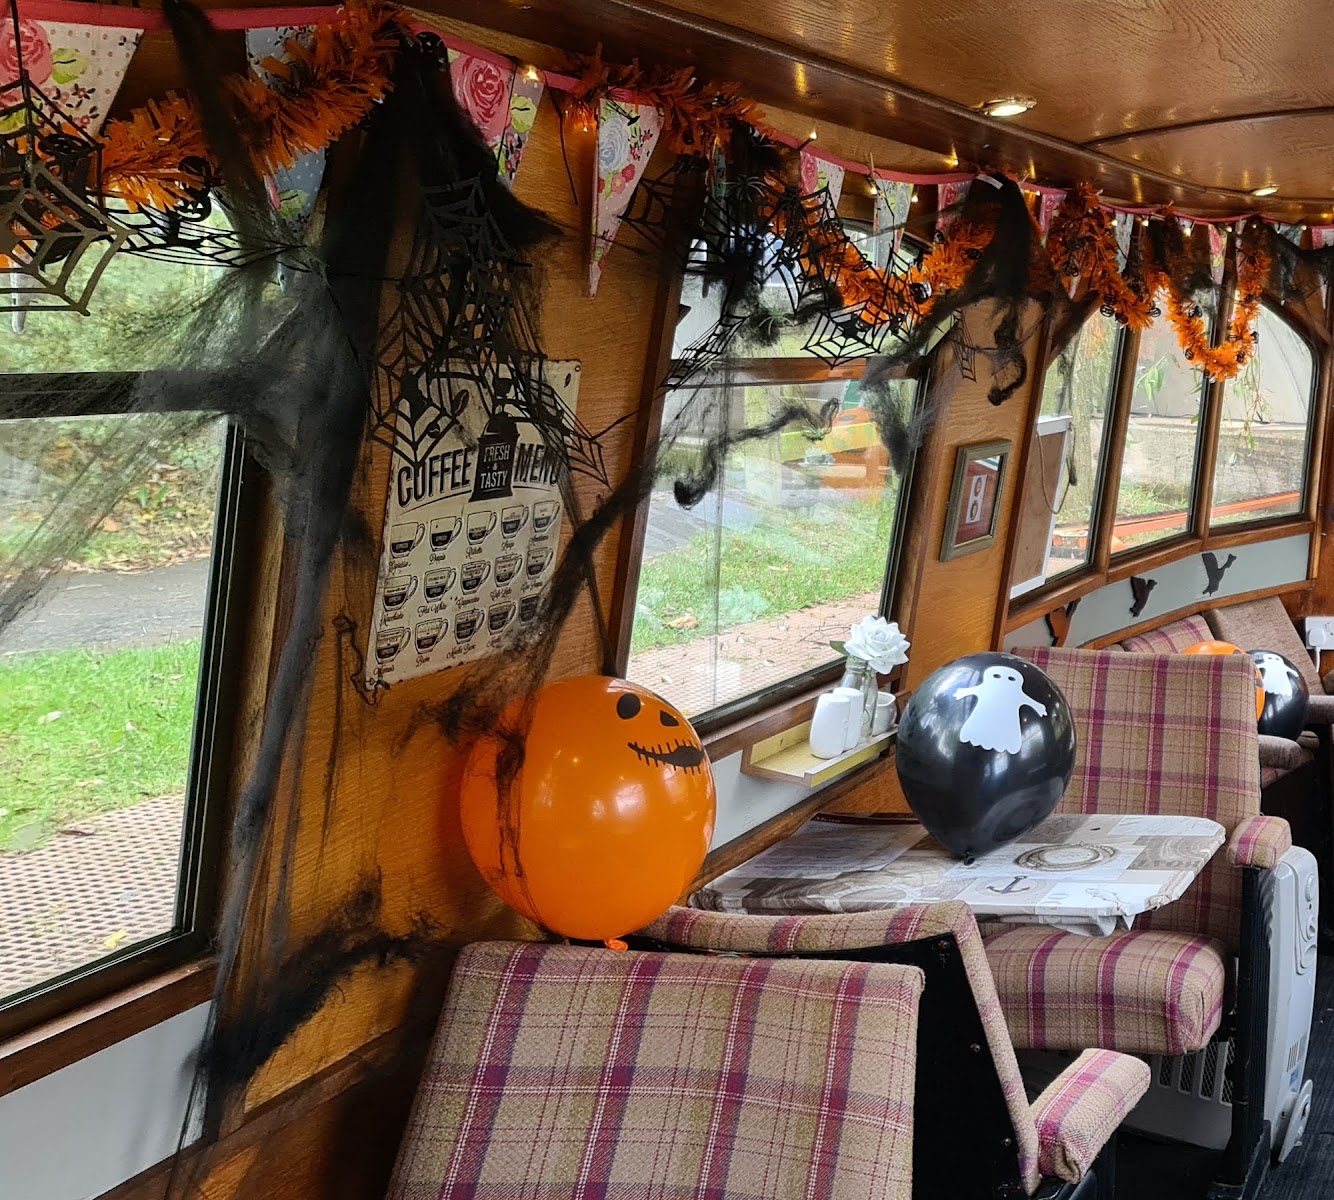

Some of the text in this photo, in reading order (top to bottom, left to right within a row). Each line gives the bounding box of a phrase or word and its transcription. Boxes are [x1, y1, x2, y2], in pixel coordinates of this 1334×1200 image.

[483, 444, 511, 463] FRESH
[398, 448, 475, 508] COFFEE
[480, 471, 508, 489] TASTY
